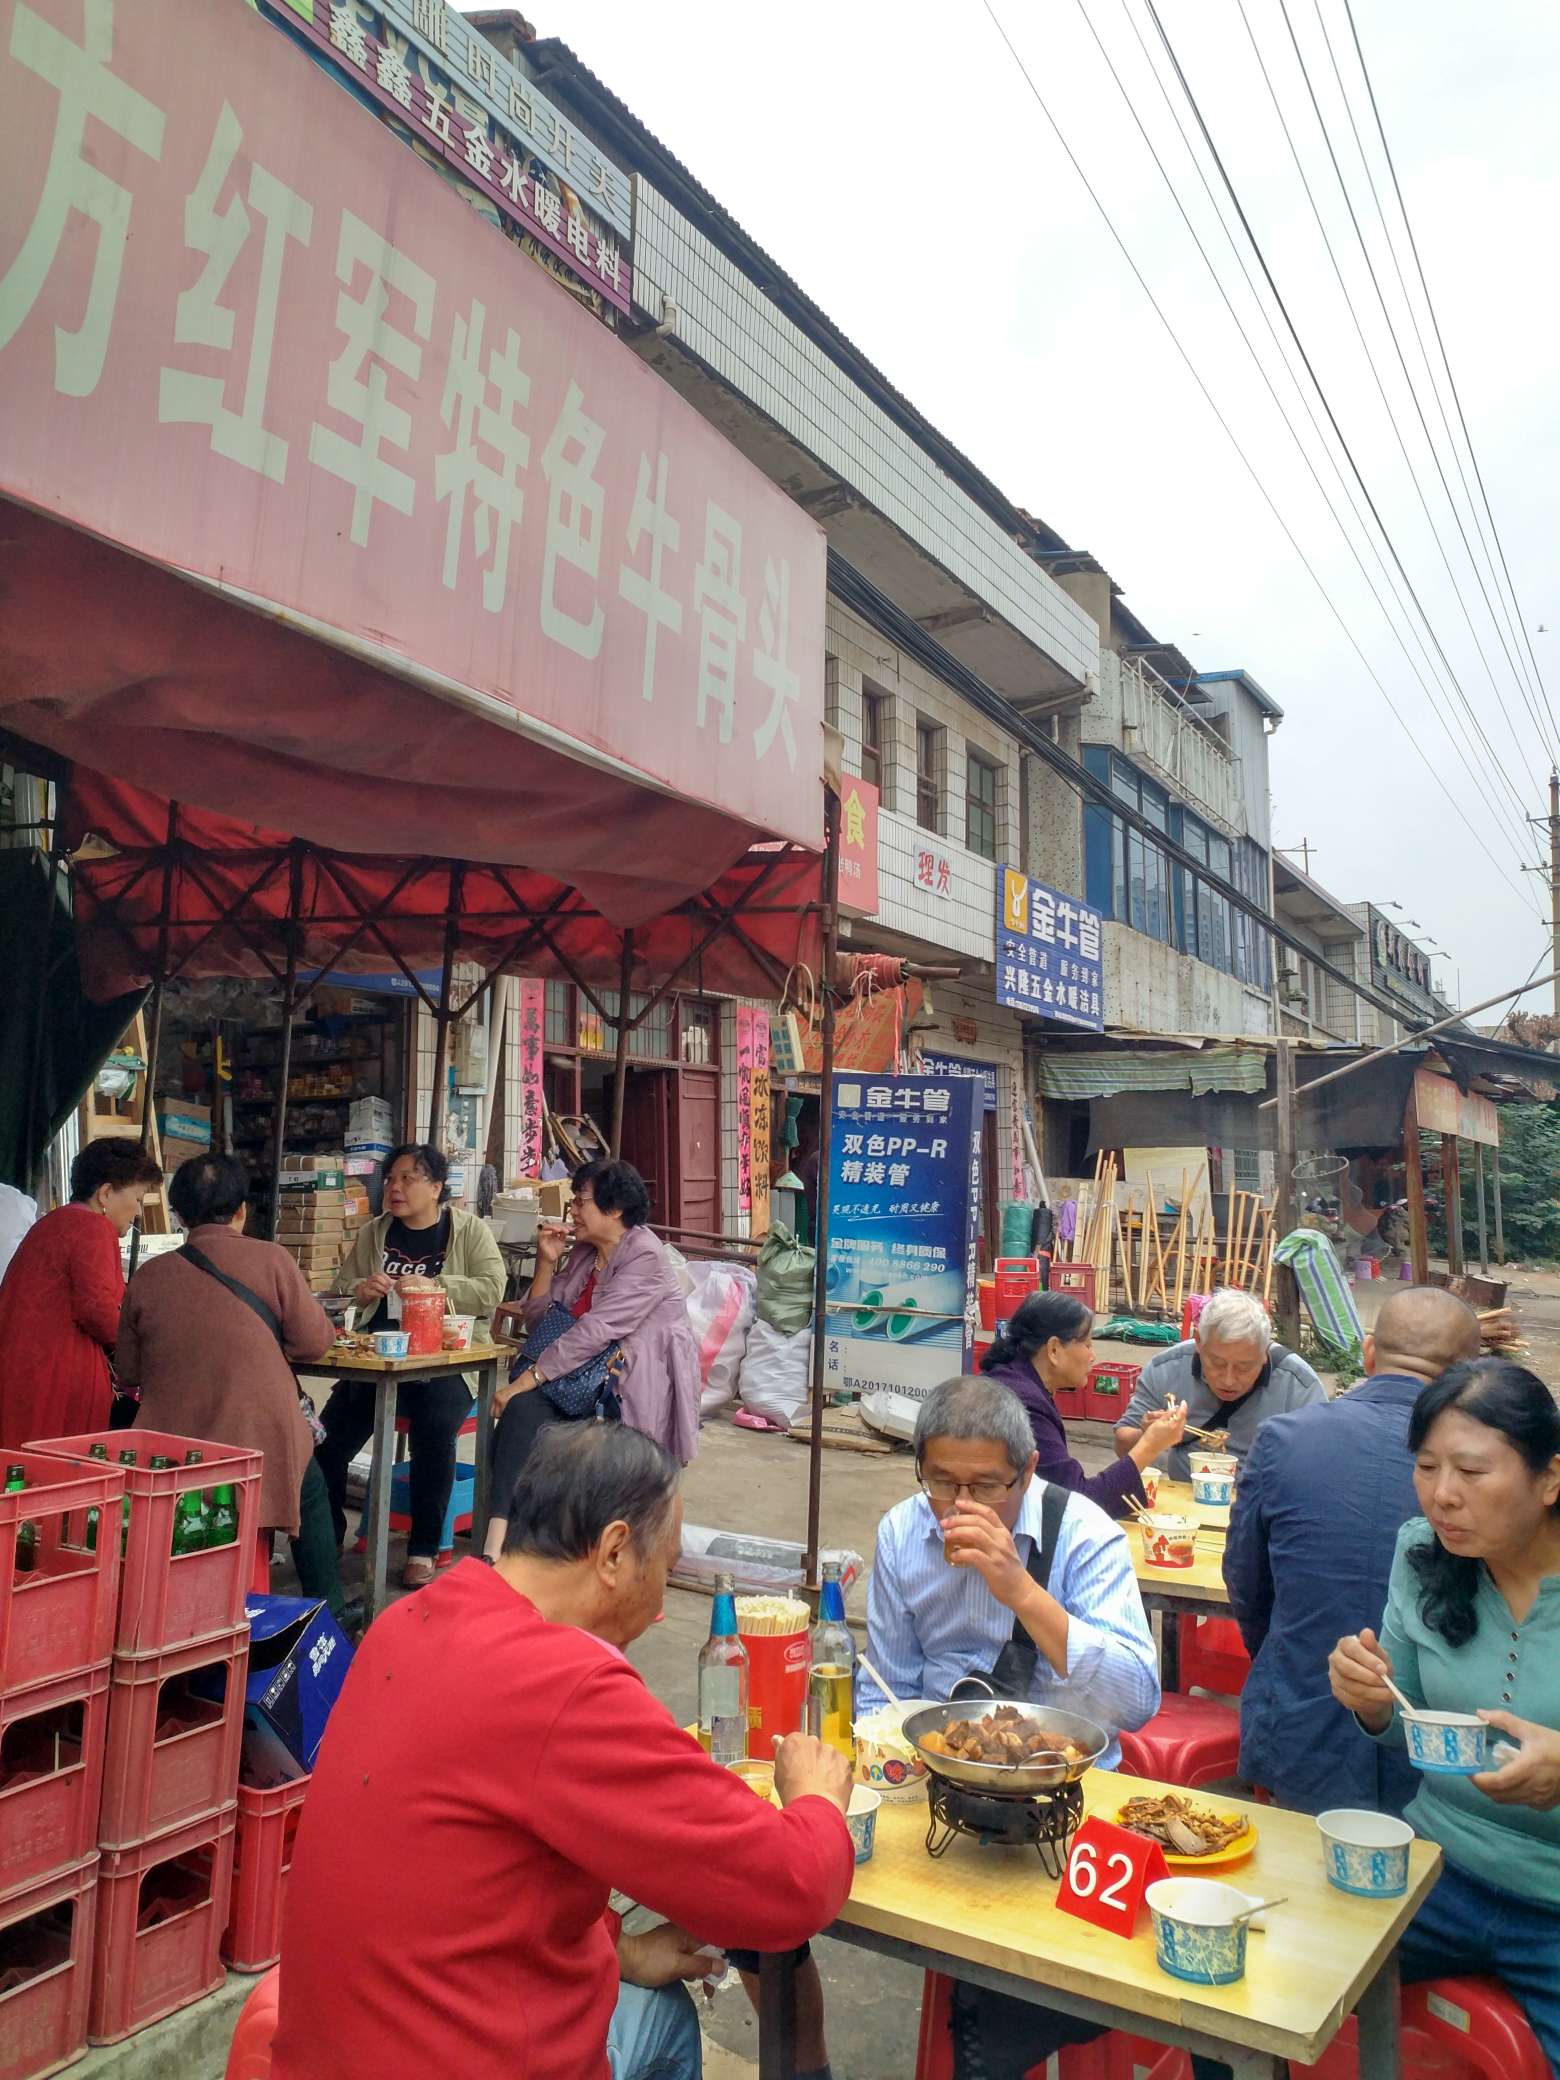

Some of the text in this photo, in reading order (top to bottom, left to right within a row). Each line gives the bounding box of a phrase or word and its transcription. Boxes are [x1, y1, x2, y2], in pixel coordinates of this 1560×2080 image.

[328, 2, 621, 292] 鑫鑫五金水暖电料
[0, 0, 803, 762] 方红军特色牛骨头
[843, 788, 866, 850] 食
[917, 850, 951, 897] 理发
[1031, 887, 1099, 962] 金牛管
[1005, 938, 1048, 971] 安全管道
[1004, 965, 1100, 1016] 兴隆五金水暖洁具
[866, 1086, 950, 1111] 金牛管
[840, 1160, 911, 1187] 精装管
[1069, 1843, 1134, 1911] 62
